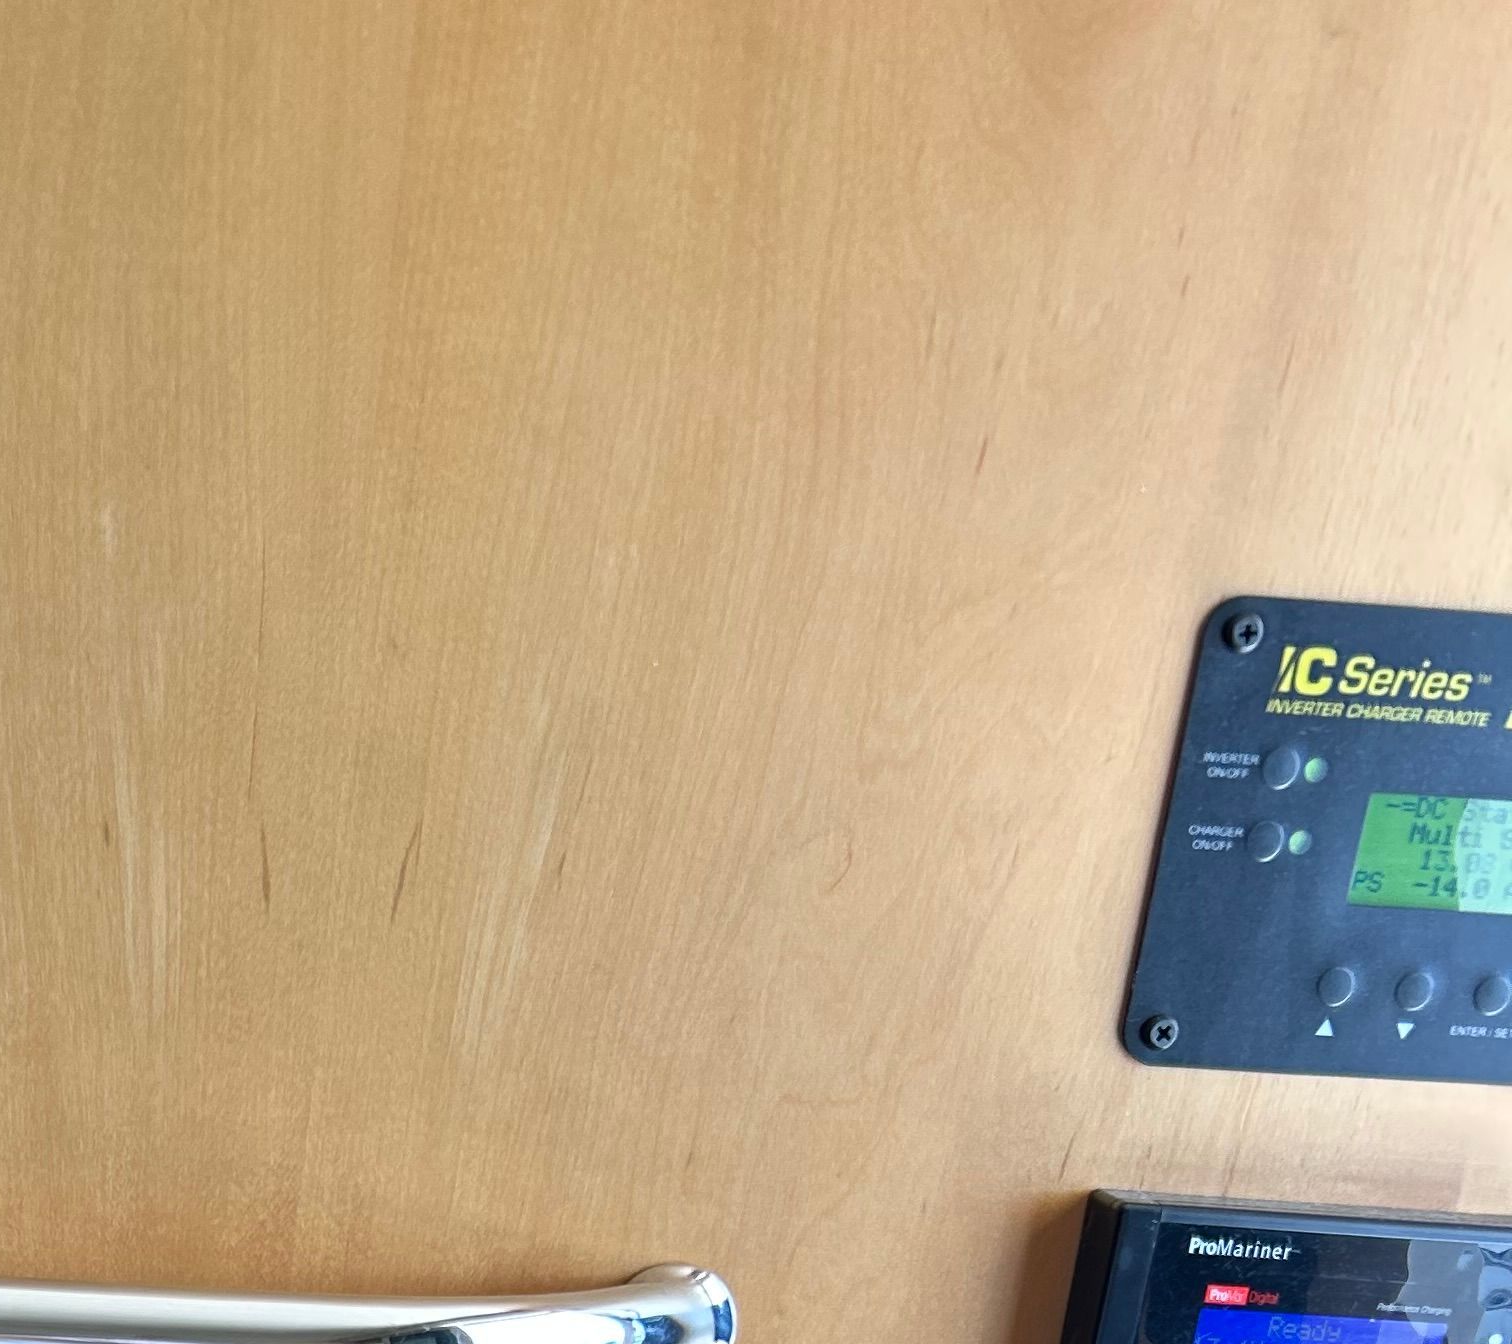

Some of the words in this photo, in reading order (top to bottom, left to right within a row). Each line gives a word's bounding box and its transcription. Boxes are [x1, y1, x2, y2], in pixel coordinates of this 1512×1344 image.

[1338, 654, 1473, 702] Series
[1265, 699, 1343, 717] INVERTER
[1345, 703, 1424, 722] CHARGER
[1424, 708, 1491, 727] REMOTE
[1202, 752, 1260, 766] INVERTER
[1189, 825, 1244, 838] CHARGER
[1188, 1236, 1292, 1261] ProMariner
[1267, 1316, 1341, 1342] Ready
